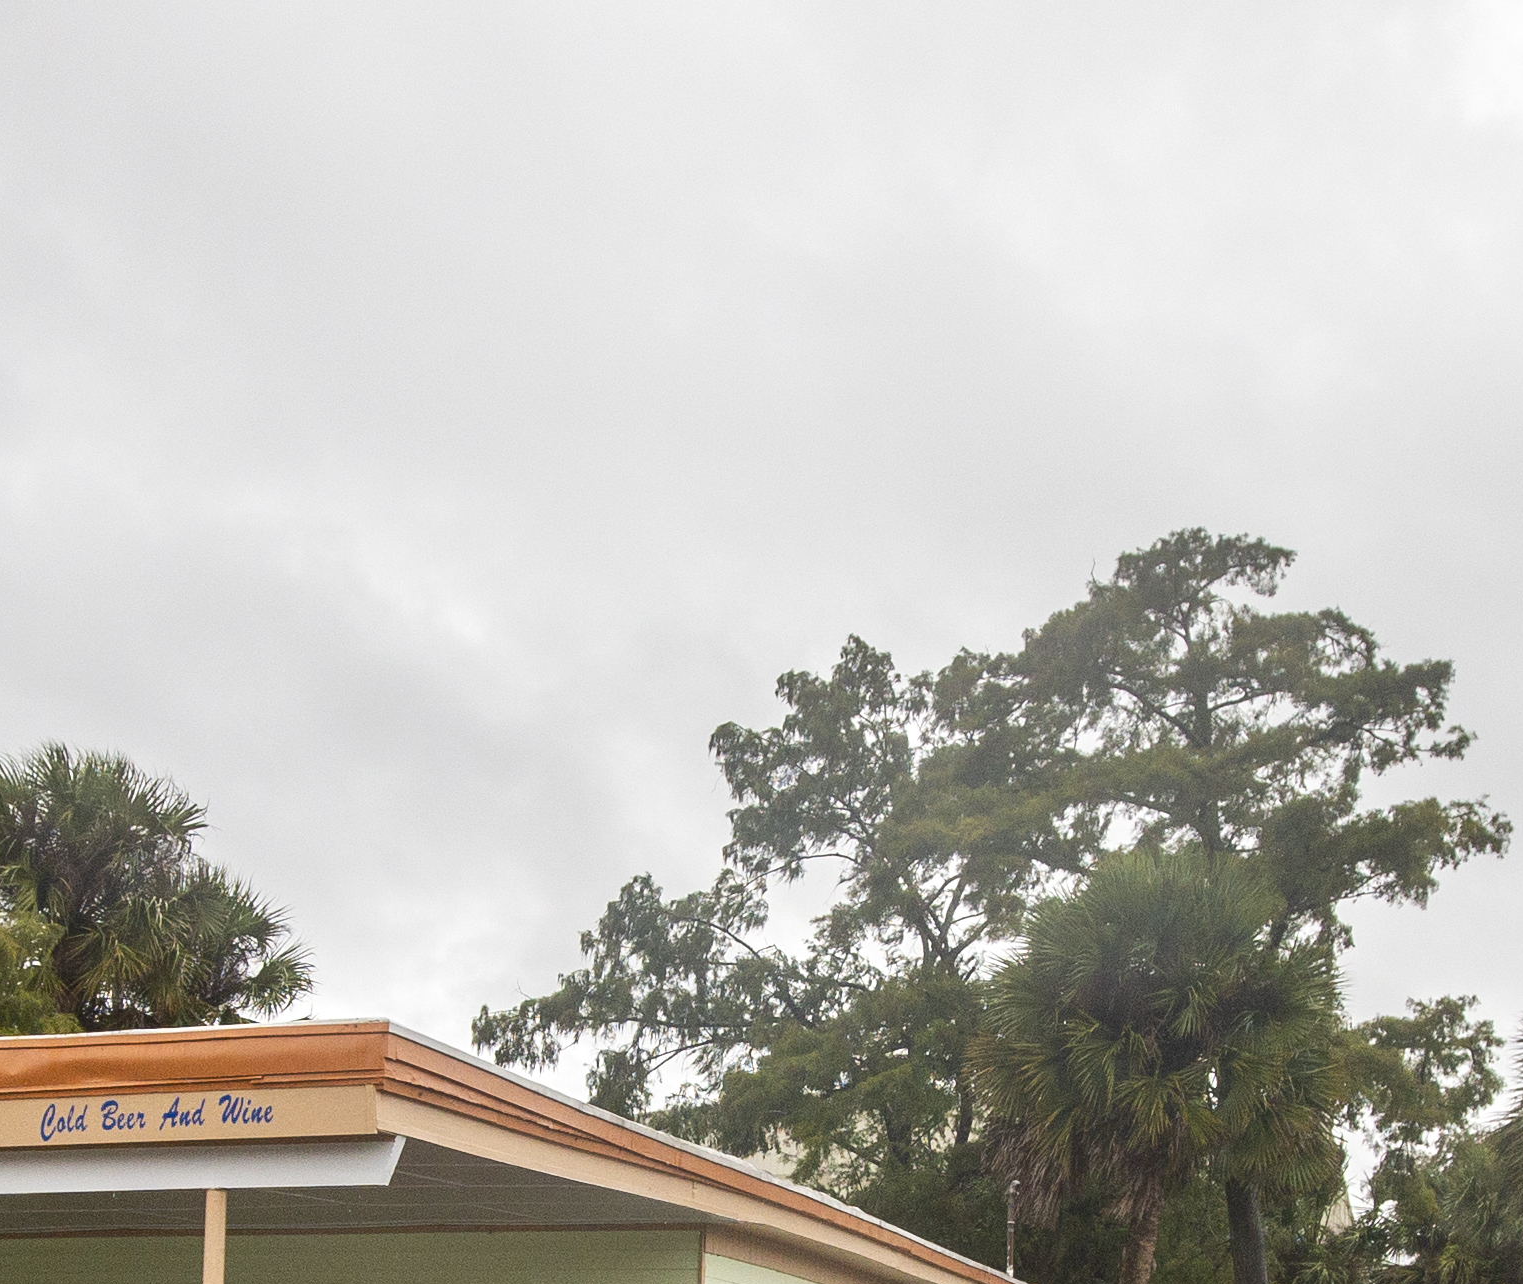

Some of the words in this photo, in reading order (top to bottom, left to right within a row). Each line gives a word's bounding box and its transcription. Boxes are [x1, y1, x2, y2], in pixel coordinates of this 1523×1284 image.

[40, 1103, 88, 1141] Cold
[101, 1100, 146, 1131] Beer
[159, 1097, 206, 1131] And
[218, 1094, 274, 1124] Wine
